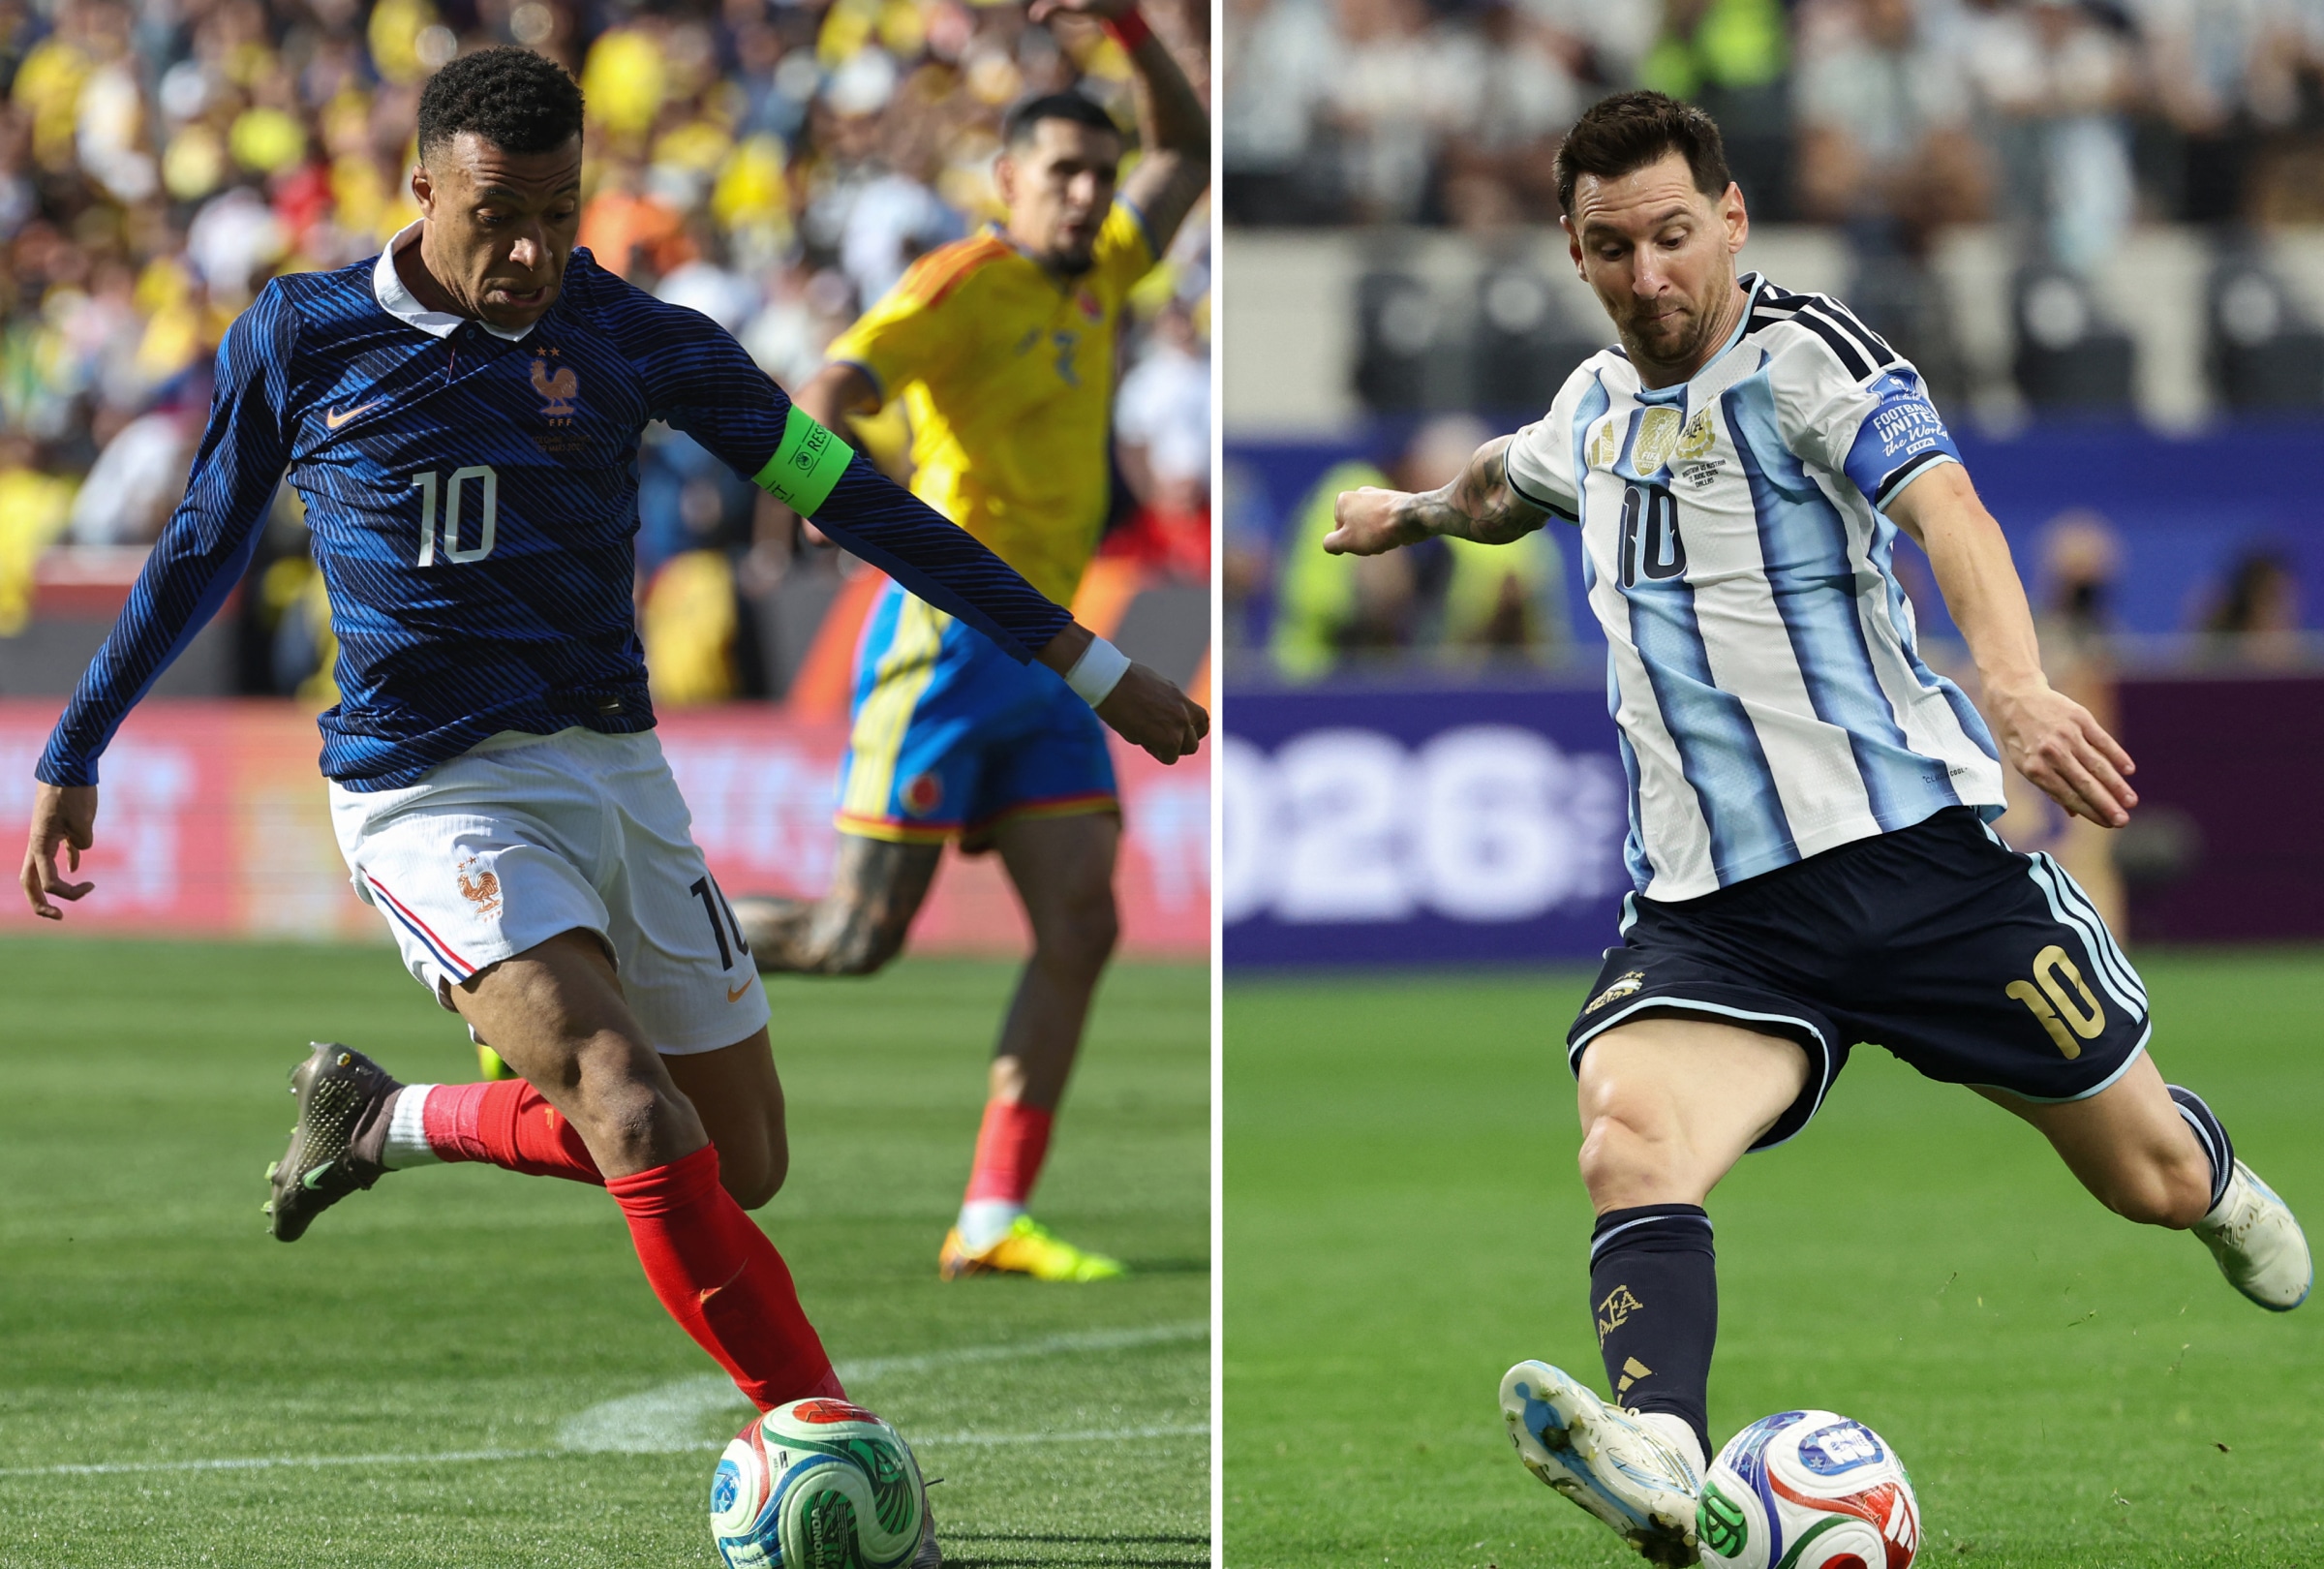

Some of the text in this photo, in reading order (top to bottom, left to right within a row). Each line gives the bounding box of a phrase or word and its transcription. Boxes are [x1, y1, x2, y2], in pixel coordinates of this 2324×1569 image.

[549, 418, 572, 427] FFF
[1882, 424, 1948, 457] the World
[1909, 439, 1935, 453] FIFA
[1641, 451, 1661, 462] FIFA
[1695, 477, 1715, 488] DALLAS
[413, 465, 499, 568] 10
[1623, 484, 1688, 589] 10
[2004, 944, 2106, 1061] 10
